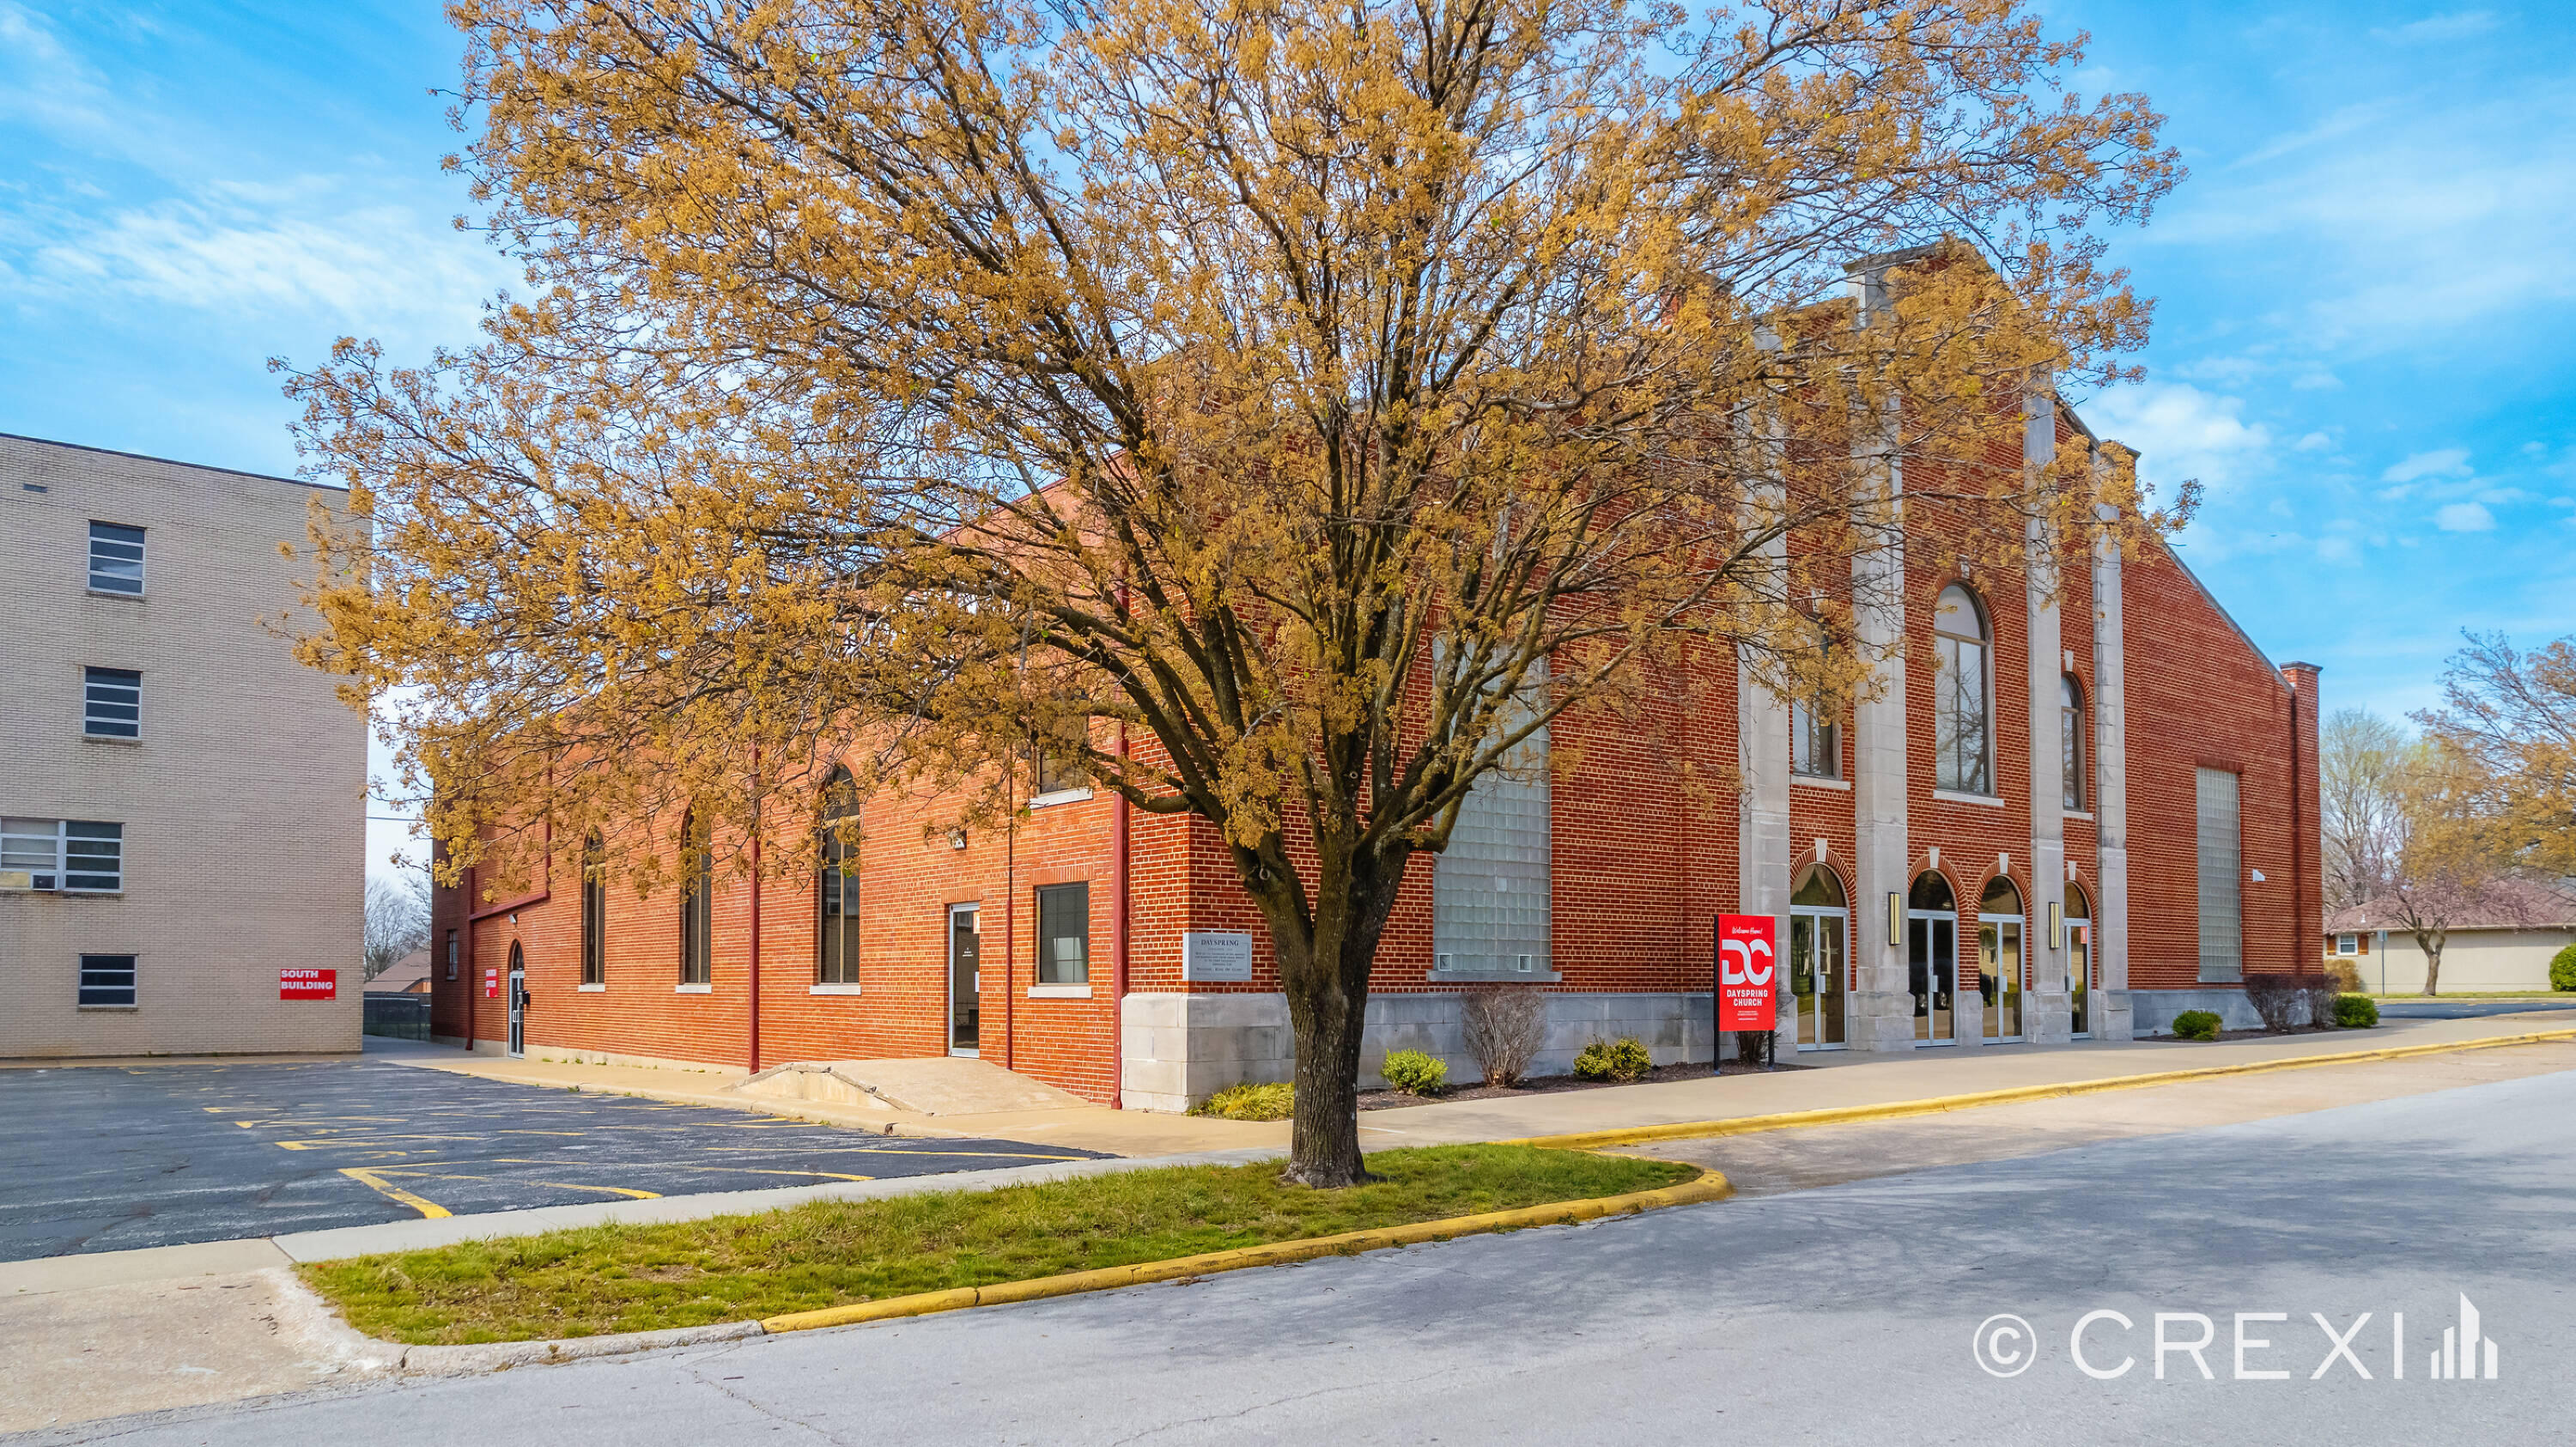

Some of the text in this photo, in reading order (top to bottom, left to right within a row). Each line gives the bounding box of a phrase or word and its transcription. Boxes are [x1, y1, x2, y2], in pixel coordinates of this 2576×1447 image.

[1722, 939, 1772, 986] DC
[282, 970, 319, 978] SOUTH
[282, 981, 333, 989] BUILDING
[1727, 989, 1768, 998] DAYSPRING
[1734, 998, 1762, 1006] CHURCH
